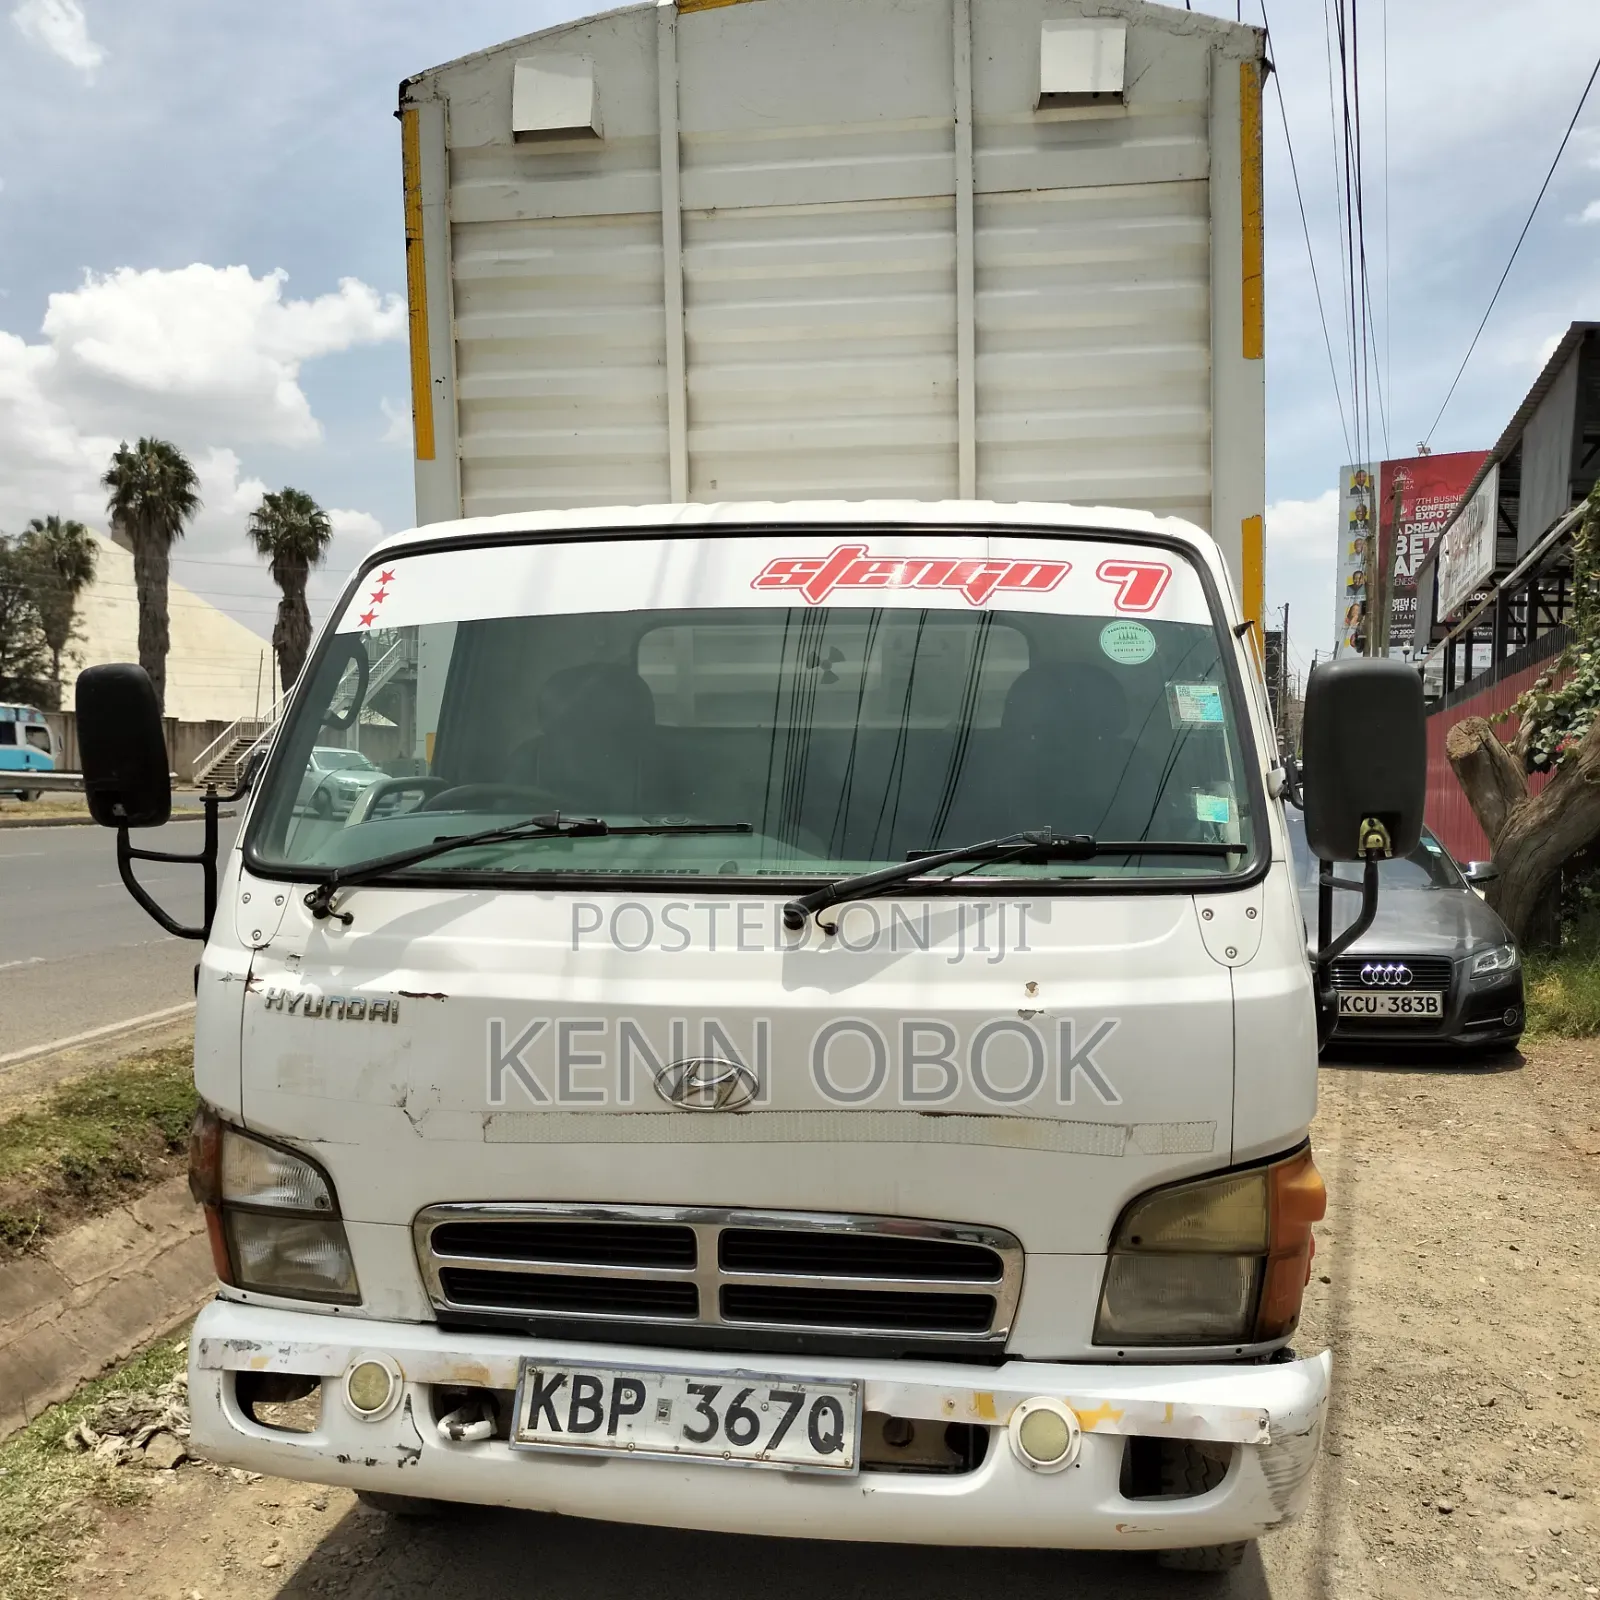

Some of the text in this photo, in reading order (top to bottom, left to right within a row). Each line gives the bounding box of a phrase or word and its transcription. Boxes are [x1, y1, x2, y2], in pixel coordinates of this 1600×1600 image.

[1416, 511, 1444, 520] EXPO
[1405, 521, 1447, 534] DREAM
[264, 987, 400, 1024] HYUNDAI
[1340, 996, 1438, 1013] KCU 383B
[527, 1372, 845, 1455] KBP 367Q
